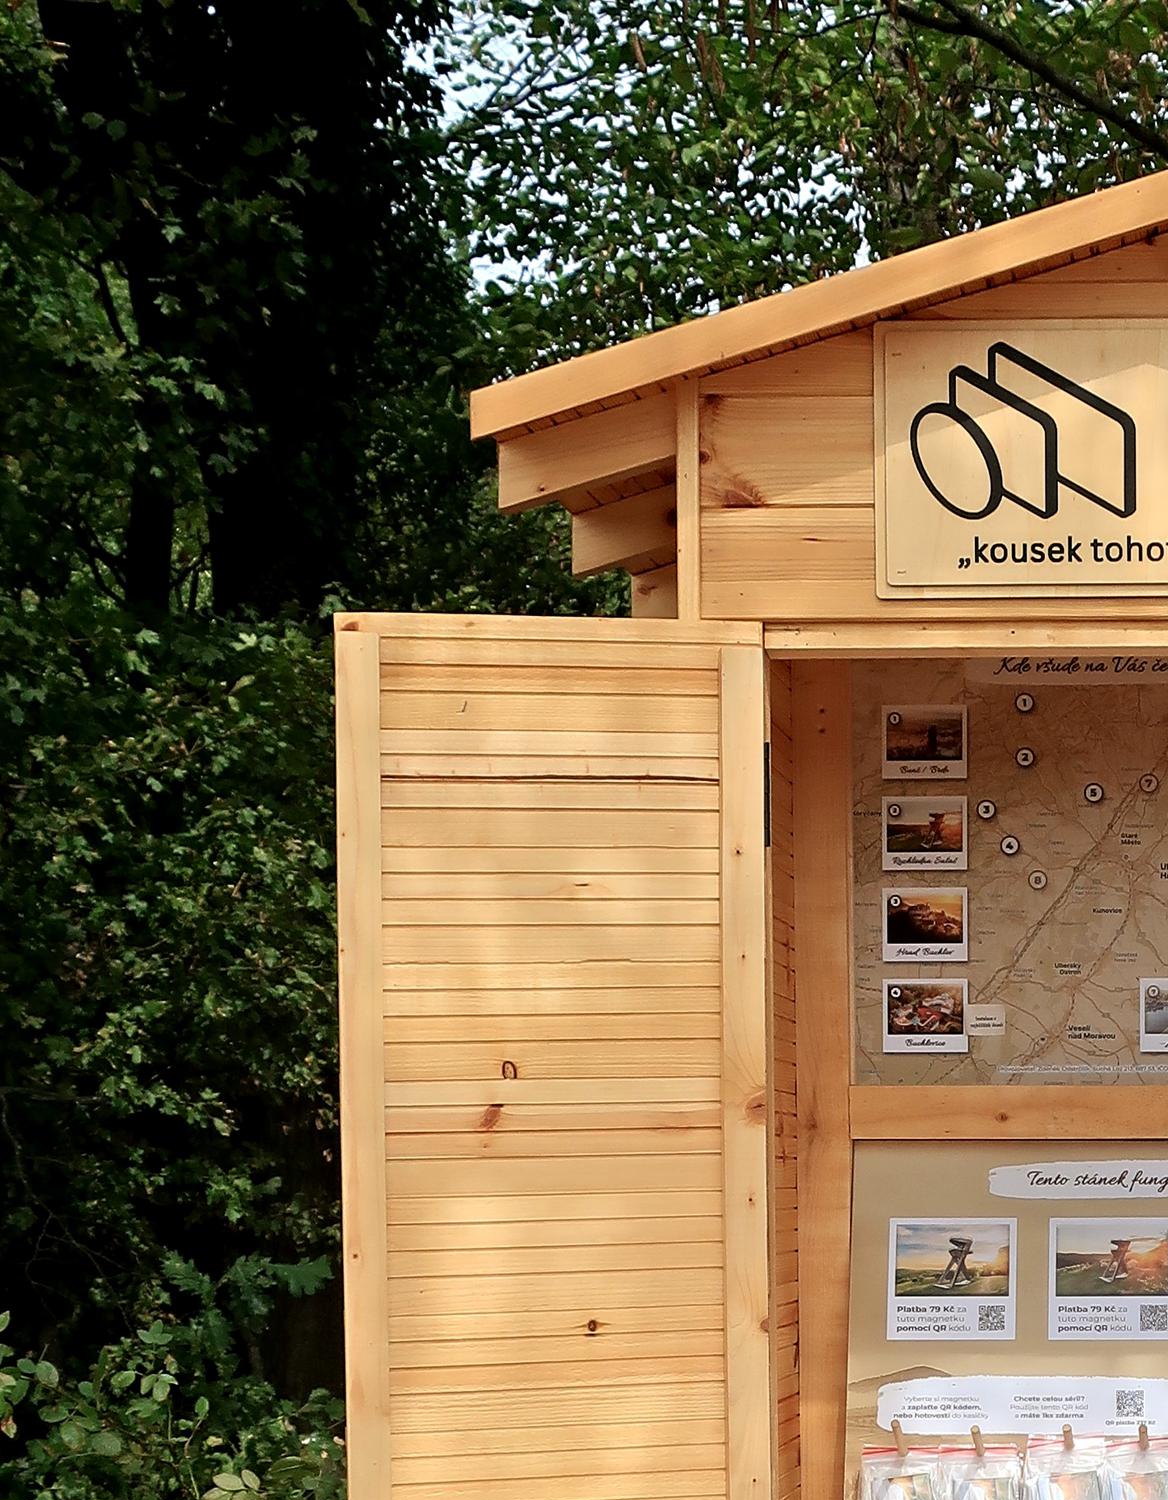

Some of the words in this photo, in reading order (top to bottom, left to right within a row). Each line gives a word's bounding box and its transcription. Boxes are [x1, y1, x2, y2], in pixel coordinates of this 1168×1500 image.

[993, 656, 1031, 675] Kde
[1036, 657, 1081, 673] všude
[1085, 663, 1107, 673] na
[1112, 656, 1148, 673] Vás
[1021, 752, 1029, 762] 2
[1144, 779, 1153, 787] 7
[1027, 1170, 1070, 1186] Tento
[1074, 1170, 1128, 1187] stánek
[943, 1305, 955, 1313] Kč
[1104, 1305, 1116, 1313] Kč
[917, 1315, 965, 1323] magnetku
[1079, 1315, 1126, 1323] magnetku
